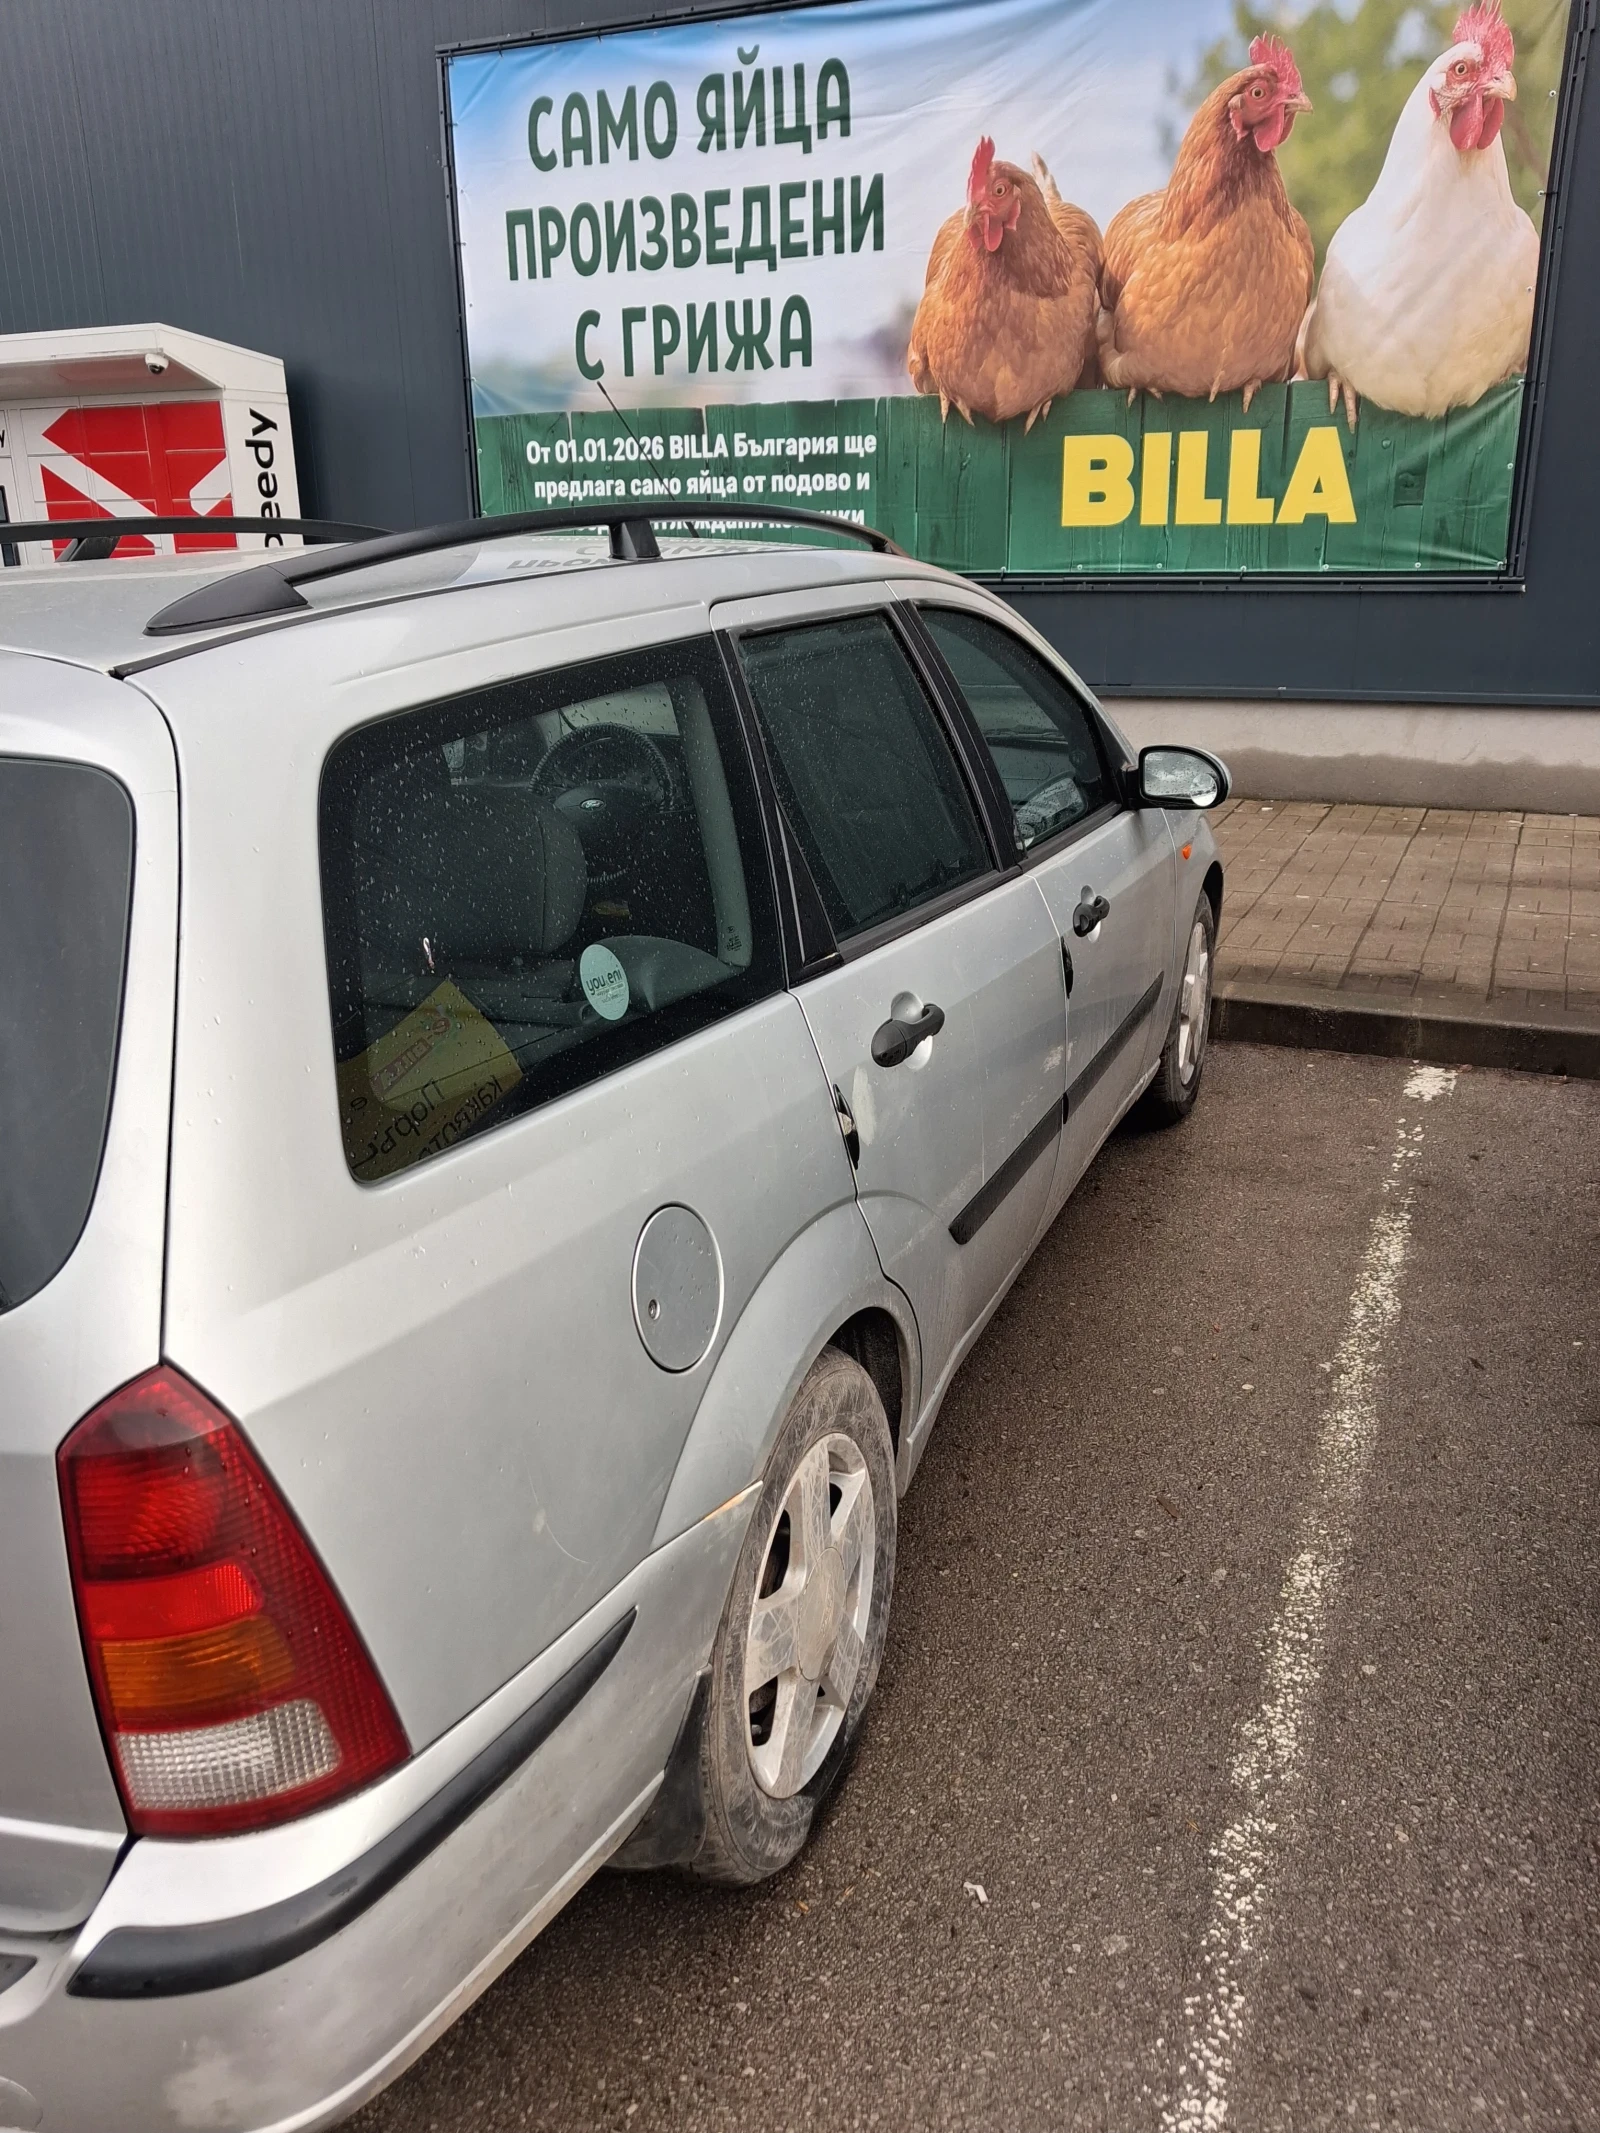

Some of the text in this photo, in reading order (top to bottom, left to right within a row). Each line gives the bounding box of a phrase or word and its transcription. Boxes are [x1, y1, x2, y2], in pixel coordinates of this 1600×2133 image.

[528, 45, 850, 171] САМО ЯЙЦА
[505, 173, 884, 280] ПРОИЗВЕДЕНИ
[575, 294, 812, 380] С ГРИЖА
[245, 407, 284, 548] eedy
[526, 432, 877, 464] От 01.01.2026 BILLA България ще
[534, 469, 870, 504] предлага само яйца от подово и
[1061, 426, 1357, 526] BILLA
